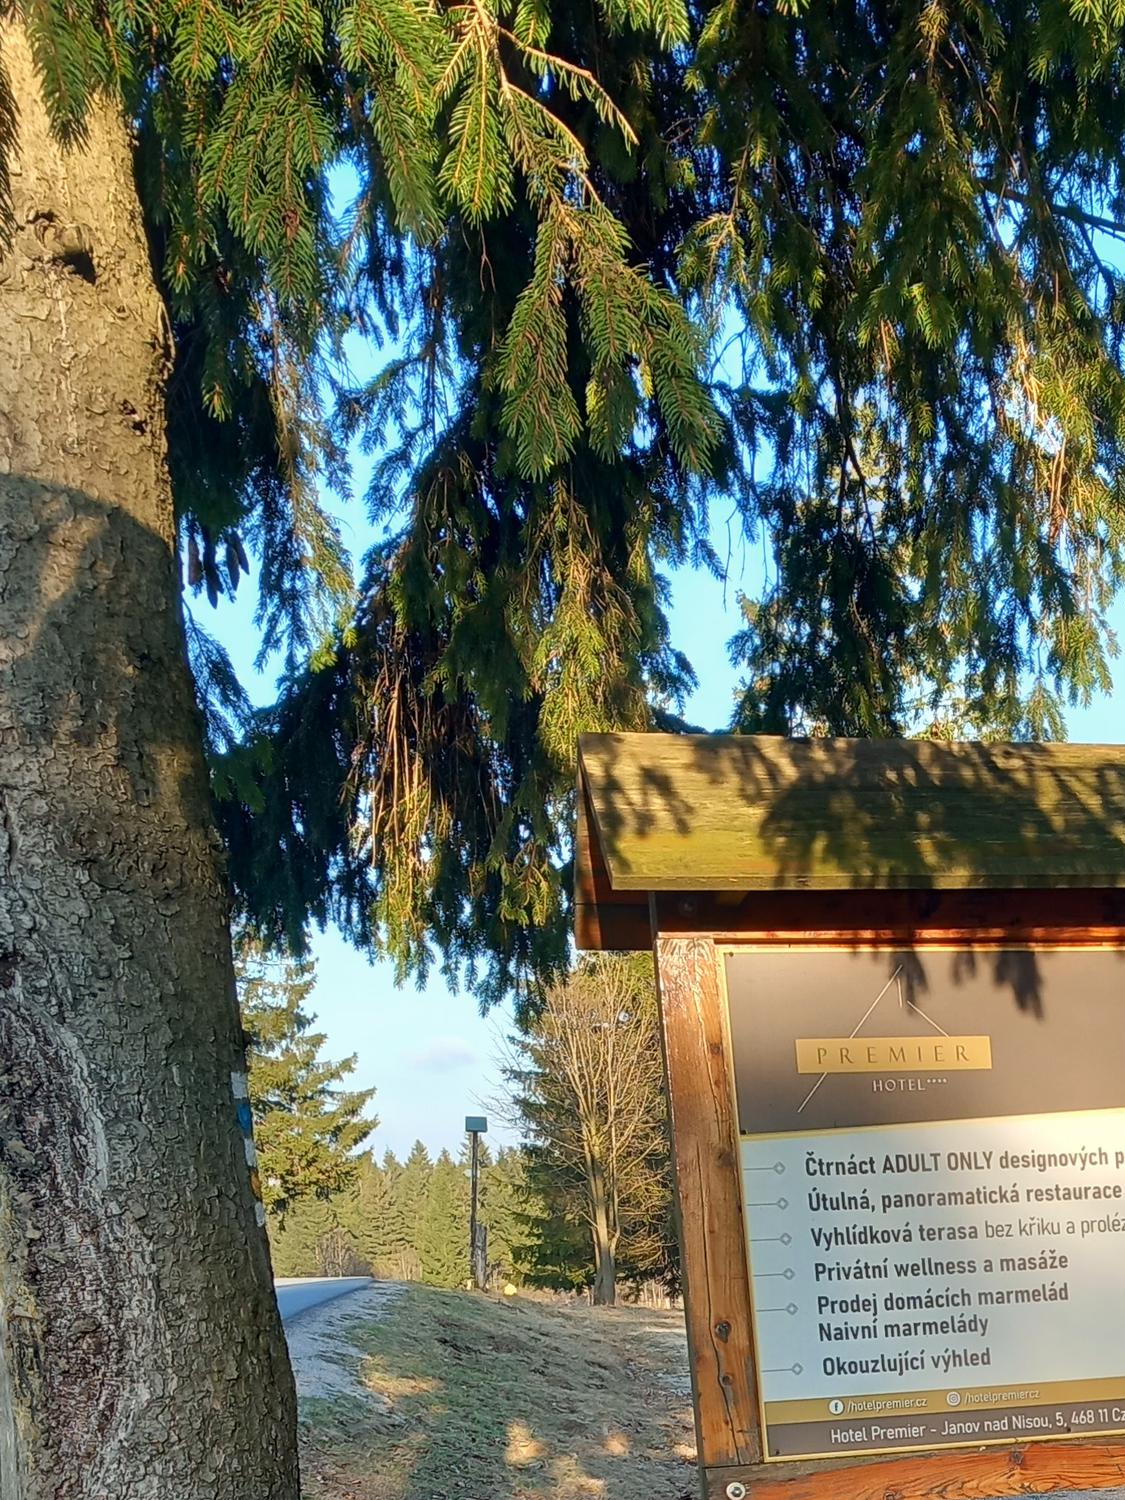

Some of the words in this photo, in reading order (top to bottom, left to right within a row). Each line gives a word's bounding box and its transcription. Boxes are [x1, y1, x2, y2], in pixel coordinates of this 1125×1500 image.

[816, 1044, 971, 1065] PREMIER
[805, 1152, 876, 1177] Čtrnáct
[882, 1152, 941, 1174] ADULT
[947, 1150, 994, 1172] ONLY
[999, 1145, 1109, 1173] designových
[808, 1187, 877, 1213] Útulná,
[881, 1184, 1021, 1214] panoramatická
[1026, 1184, 1123, 1202] restaurace
[810, 1222, 913, 1252] Vyhlídková
[918, 1223, 979, 1243] terasa
[985, 1219, 1014, 1240] bez
[1018, 1216, 1062, 1237] křiku
[1066, 1220, 1076, 1236] a
[815, 1259, 889, 1282] Privátní
[894, 1256, 977, 1278] wellness
[983, 1258, 994, 1273] a
[999, 1250, 1069, 1273] masáže
[817, 1293, 878, 1320] Prodej
[884, 1287, 972, 1312] domácích
[978, 1283, 1069, 1306] marmelád
[819, 1318, 878, 1343] Naivní
[884, 1314, 989, 1341] marmelády
[823, 1352, 925, 1379] Okouzlující
[931, 1348, 991, 1375] výhled
[830, 1424, 868, 1444] Hotel
[871, 1421, 926, 1440] Premier
[941, 1417, 980, 1436] Janov
[984, 1416, 1009, 1432] nad
[1012, 1412, 1053, 1430] Nisou,
[1055, 1411, 1068, 1428] 5,
[1071, 1409, 1095, 1425] 468
[1098, 1408, 1109, 1423] 11
